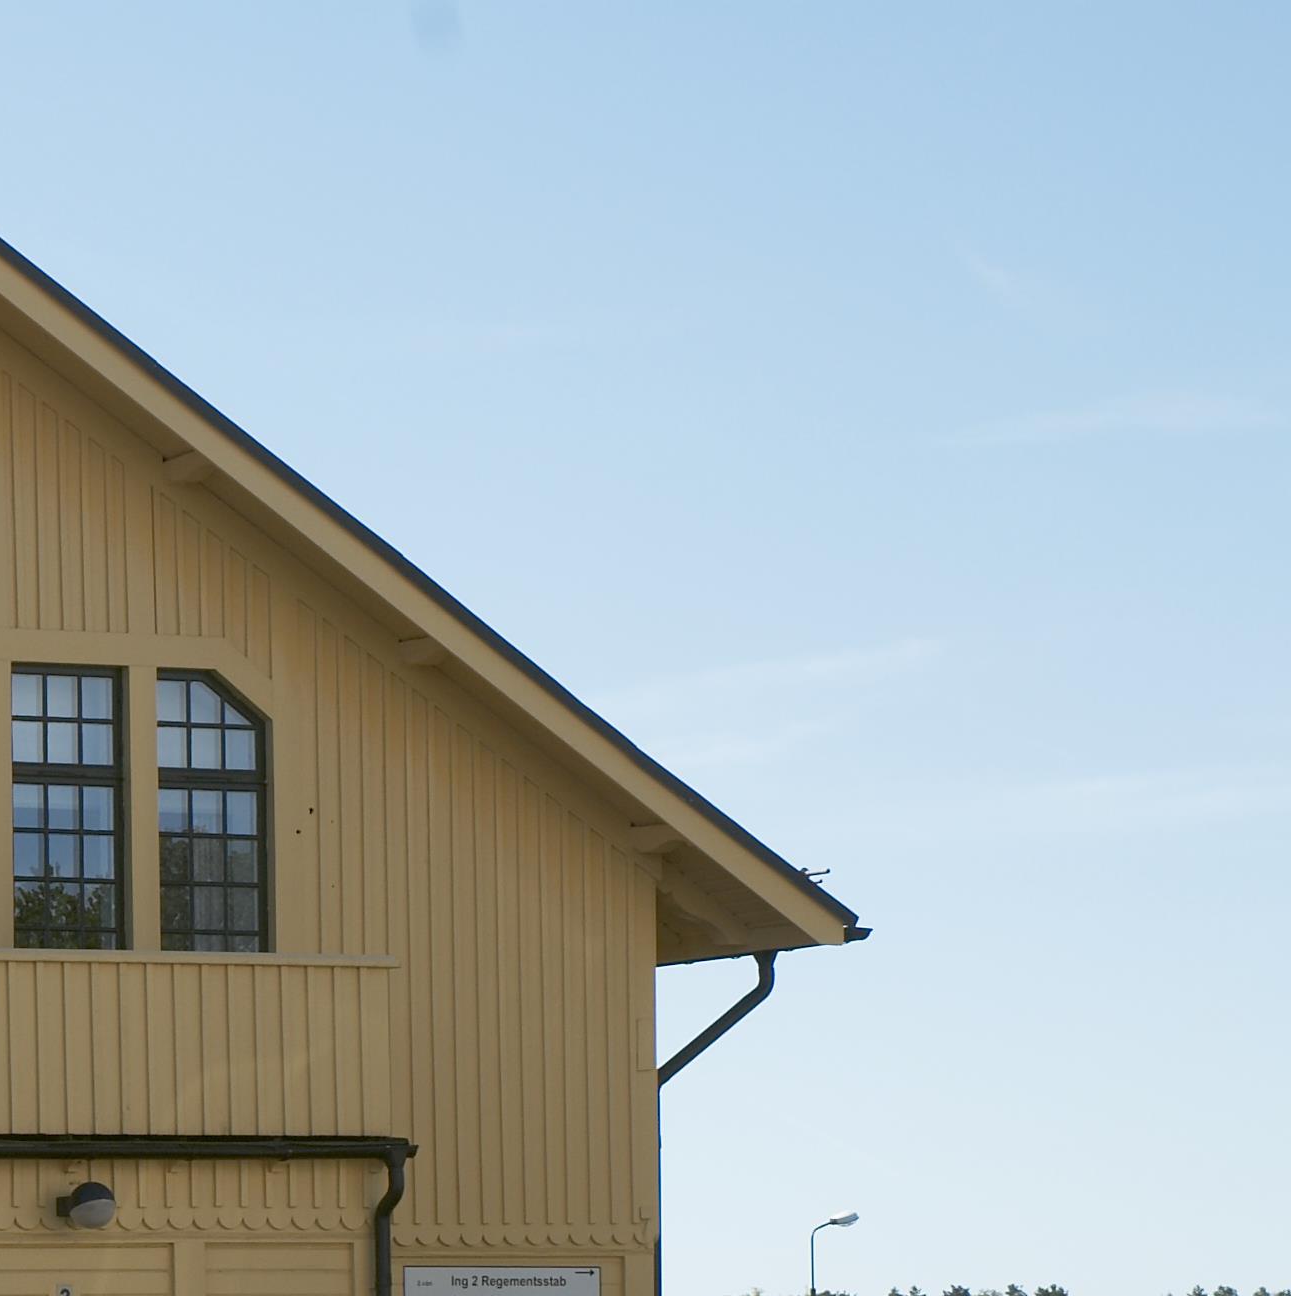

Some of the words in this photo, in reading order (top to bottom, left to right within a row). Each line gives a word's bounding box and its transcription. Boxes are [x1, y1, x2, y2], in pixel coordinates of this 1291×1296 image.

[451, 1275, 468, 1289] Ing
[471, 1275, 478, 1287] 2
[481, 1275, 567, 1289] Regementsstab
